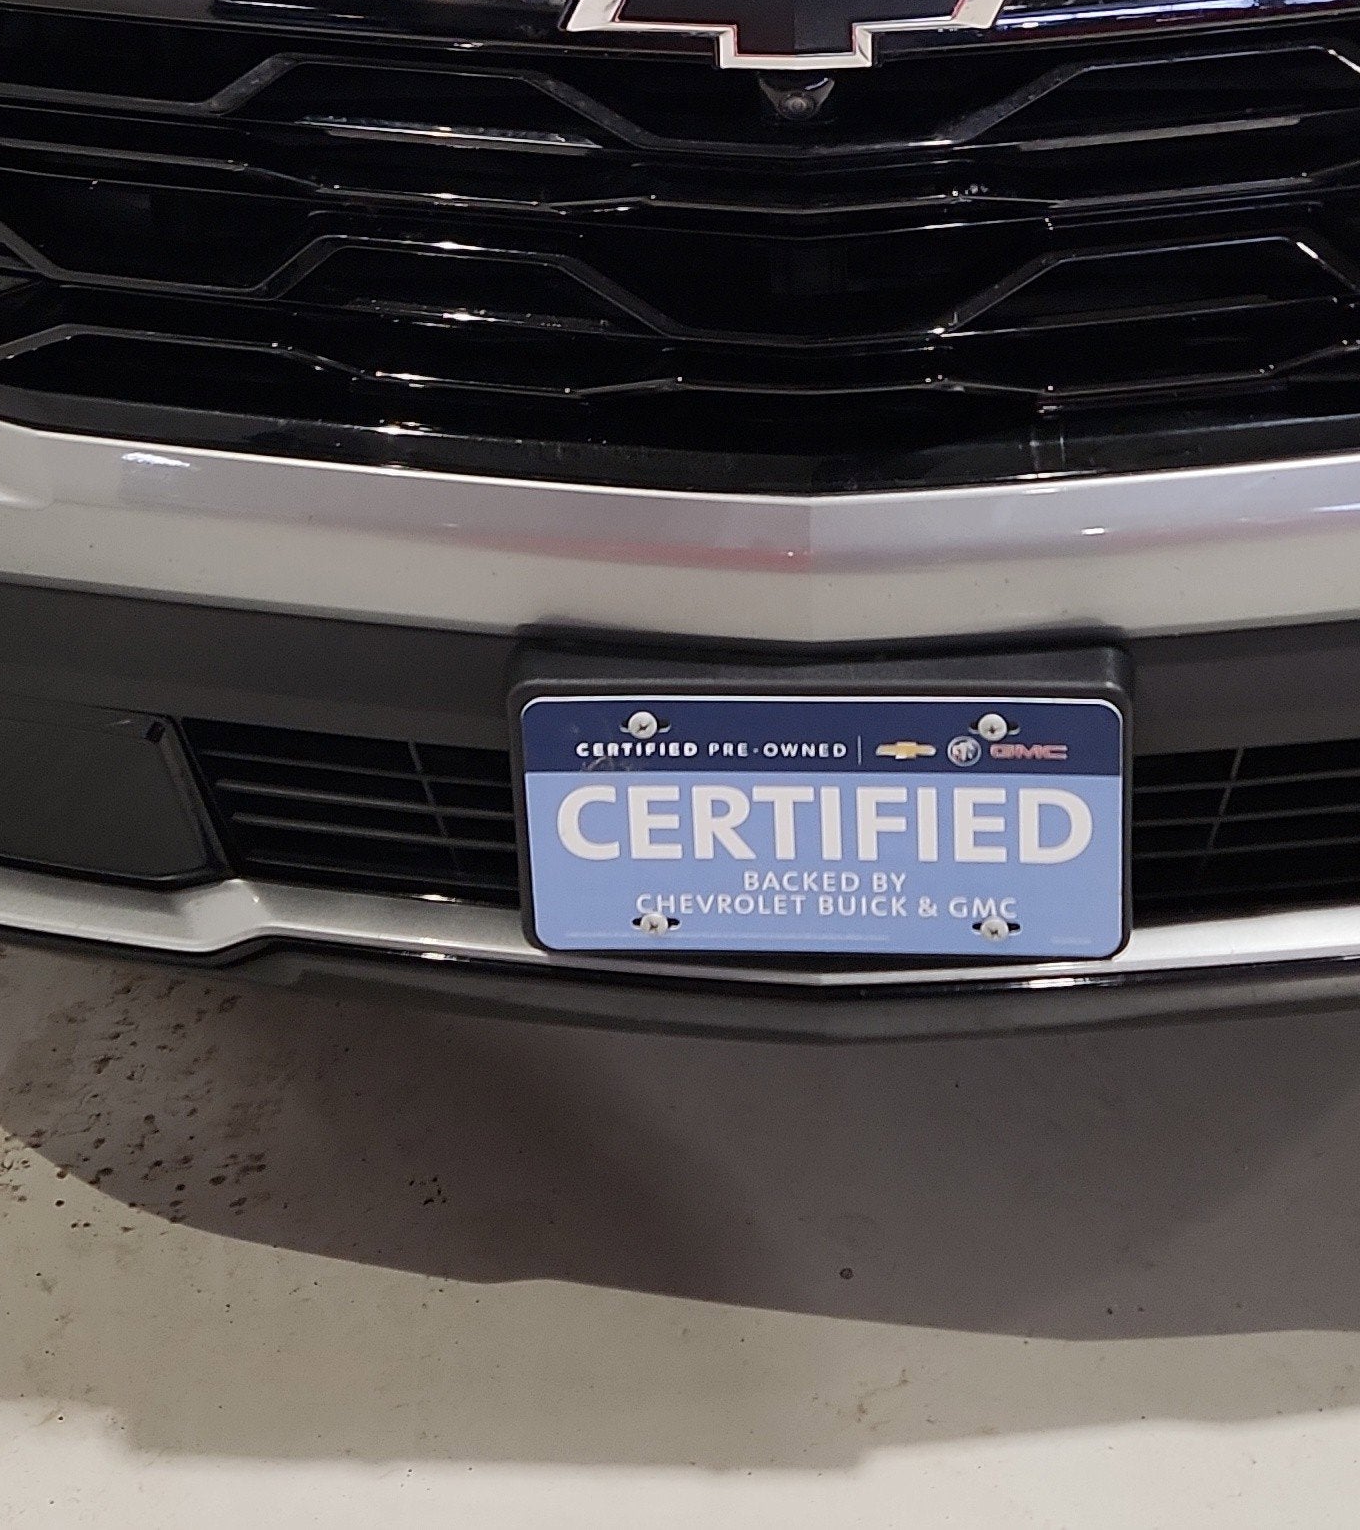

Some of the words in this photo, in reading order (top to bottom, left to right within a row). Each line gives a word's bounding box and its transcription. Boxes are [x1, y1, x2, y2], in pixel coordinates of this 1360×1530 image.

[576, 742, 698, 757] CERTIFIED
[990, 743, 1068, 761] GMC
[556, 784, 1095, 865] CERTIFIED
[744, 872, 861, 893] BACKED
[872, 874, 906, 893] BY
[635, 894, 804, 916] CHEVROLET
[819, 897, 907, 917] BUICK
[918, 899, 939, 917] &
[949, 899, 1018, 920] GMC
